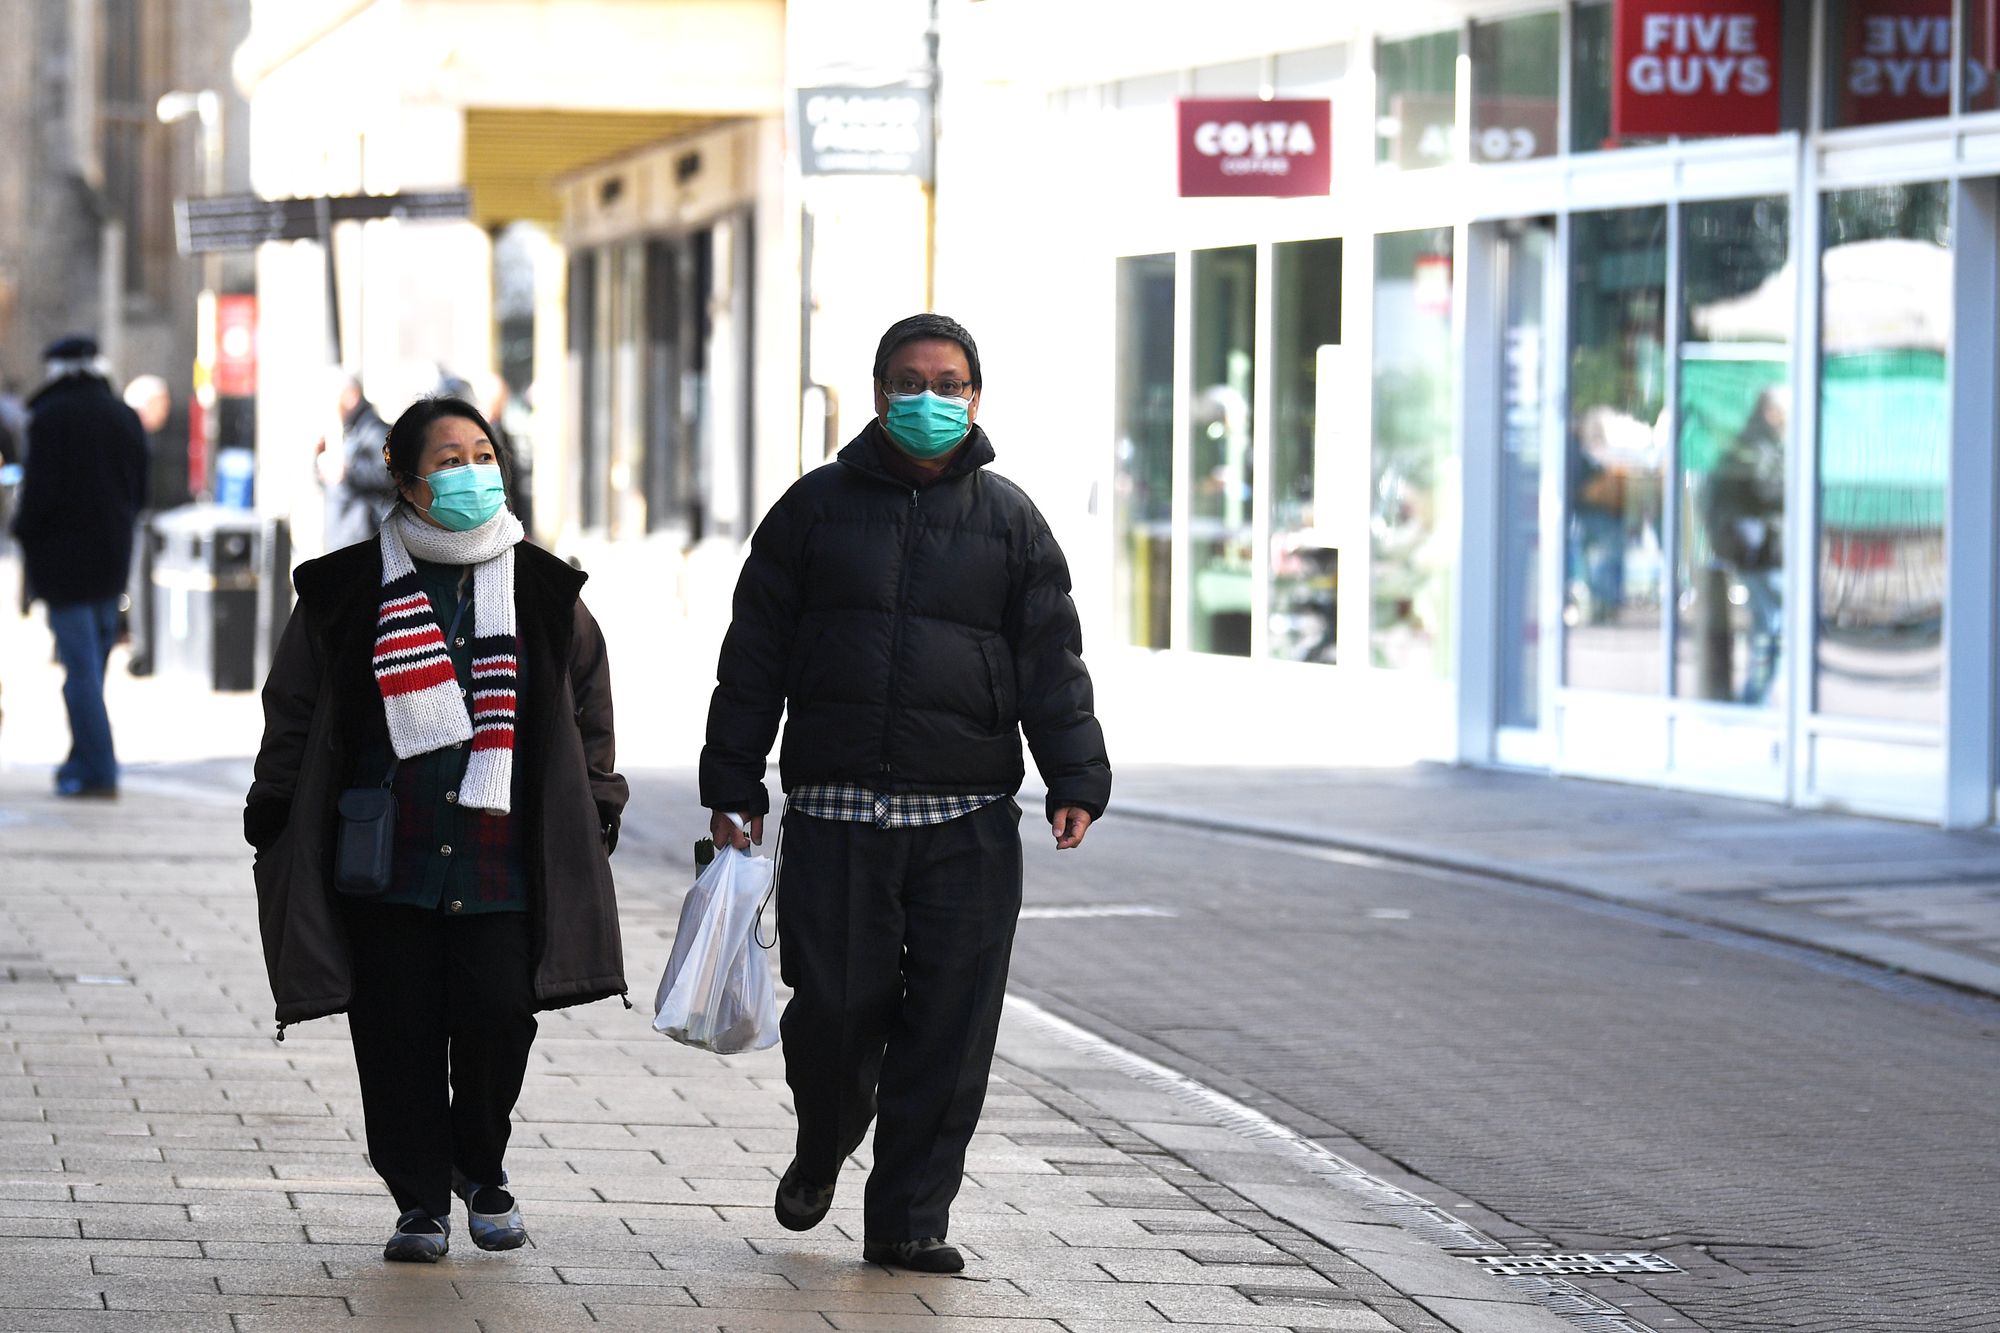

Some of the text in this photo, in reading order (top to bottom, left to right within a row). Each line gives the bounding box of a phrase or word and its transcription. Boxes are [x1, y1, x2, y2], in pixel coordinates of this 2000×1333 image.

[1643, 13, 1757, 53] FIVE
[1628, 54, 1771, 95] GUYS
[1194, 120, 1316, 158] COSTA
